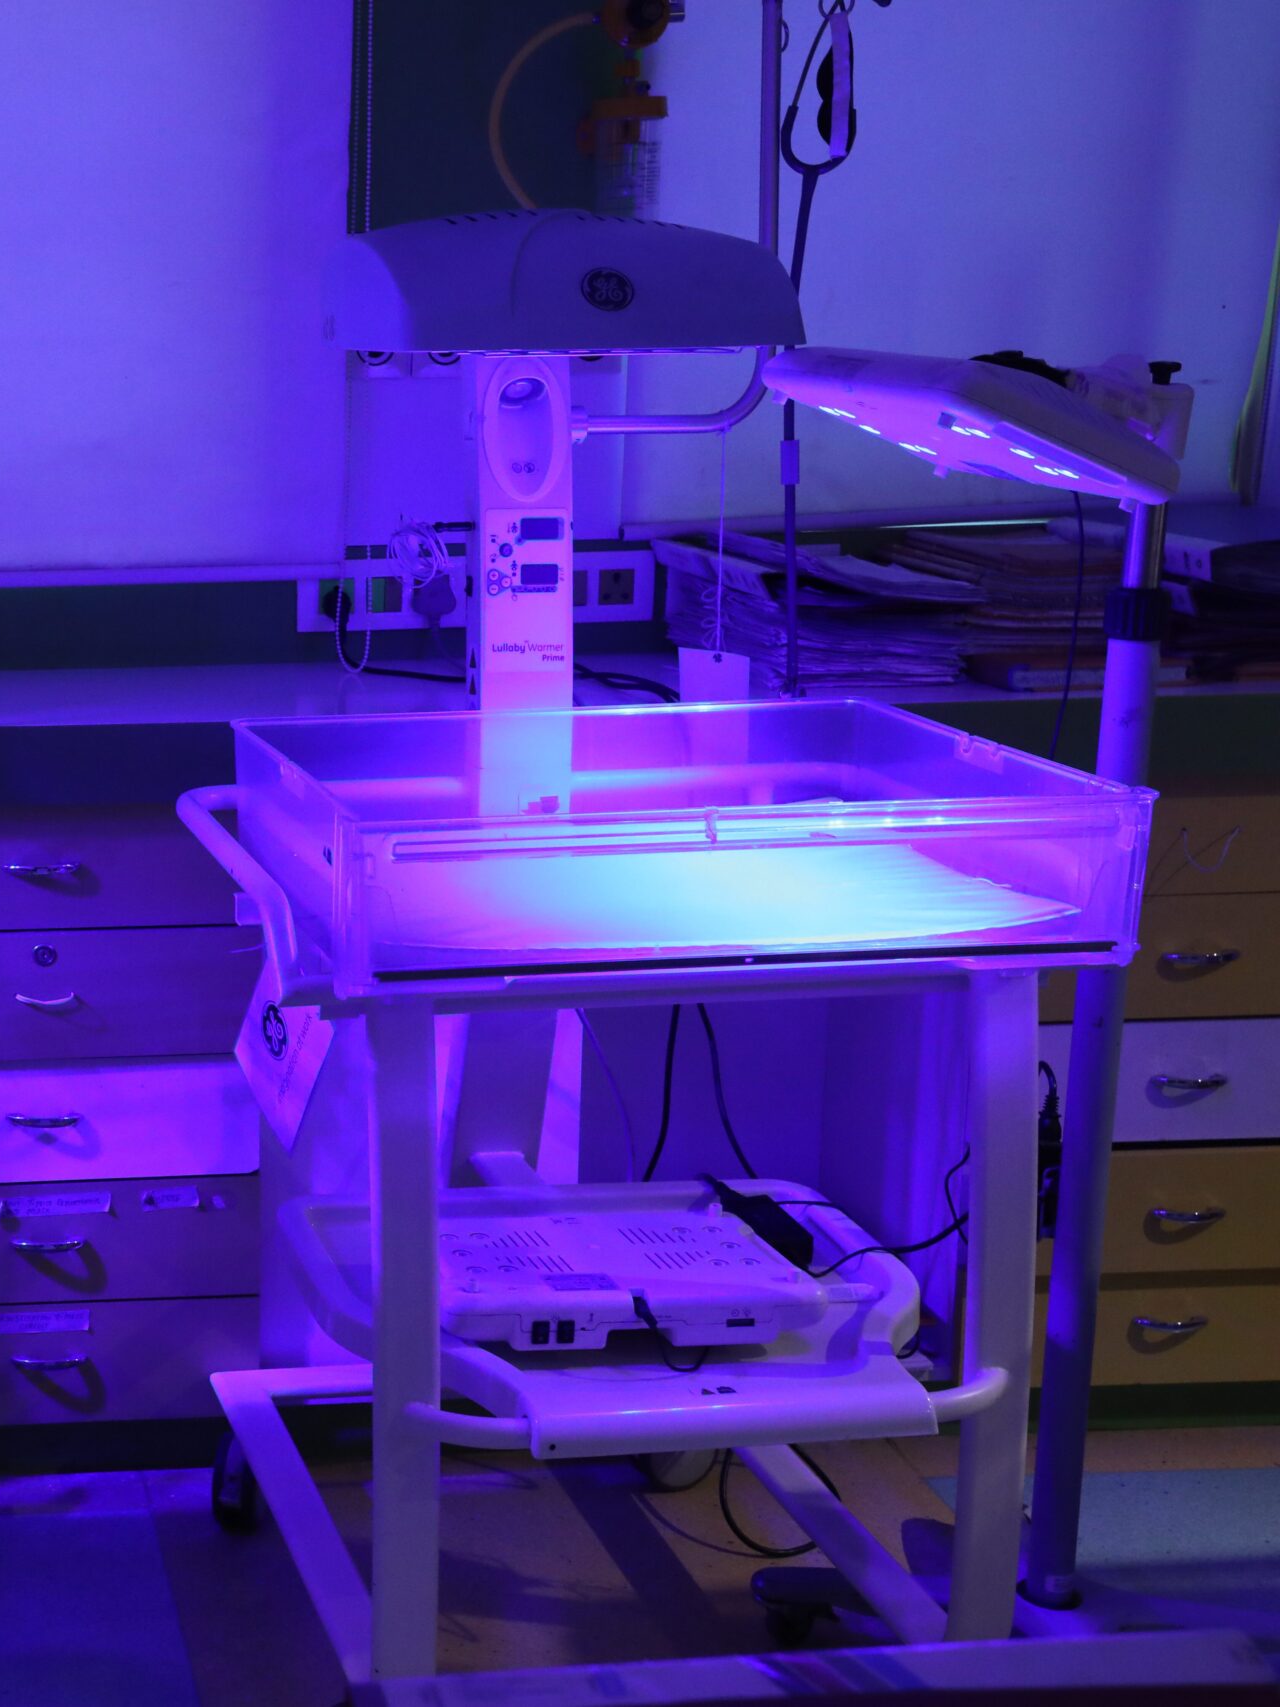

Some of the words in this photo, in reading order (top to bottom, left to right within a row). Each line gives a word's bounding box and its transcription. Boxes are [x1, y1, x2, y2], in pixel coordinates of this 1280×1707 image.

[492, 643, 526, 653] Lullaby
[527, 644, 564, 652] Warmer
[542, 654, 565, 662] Prime
